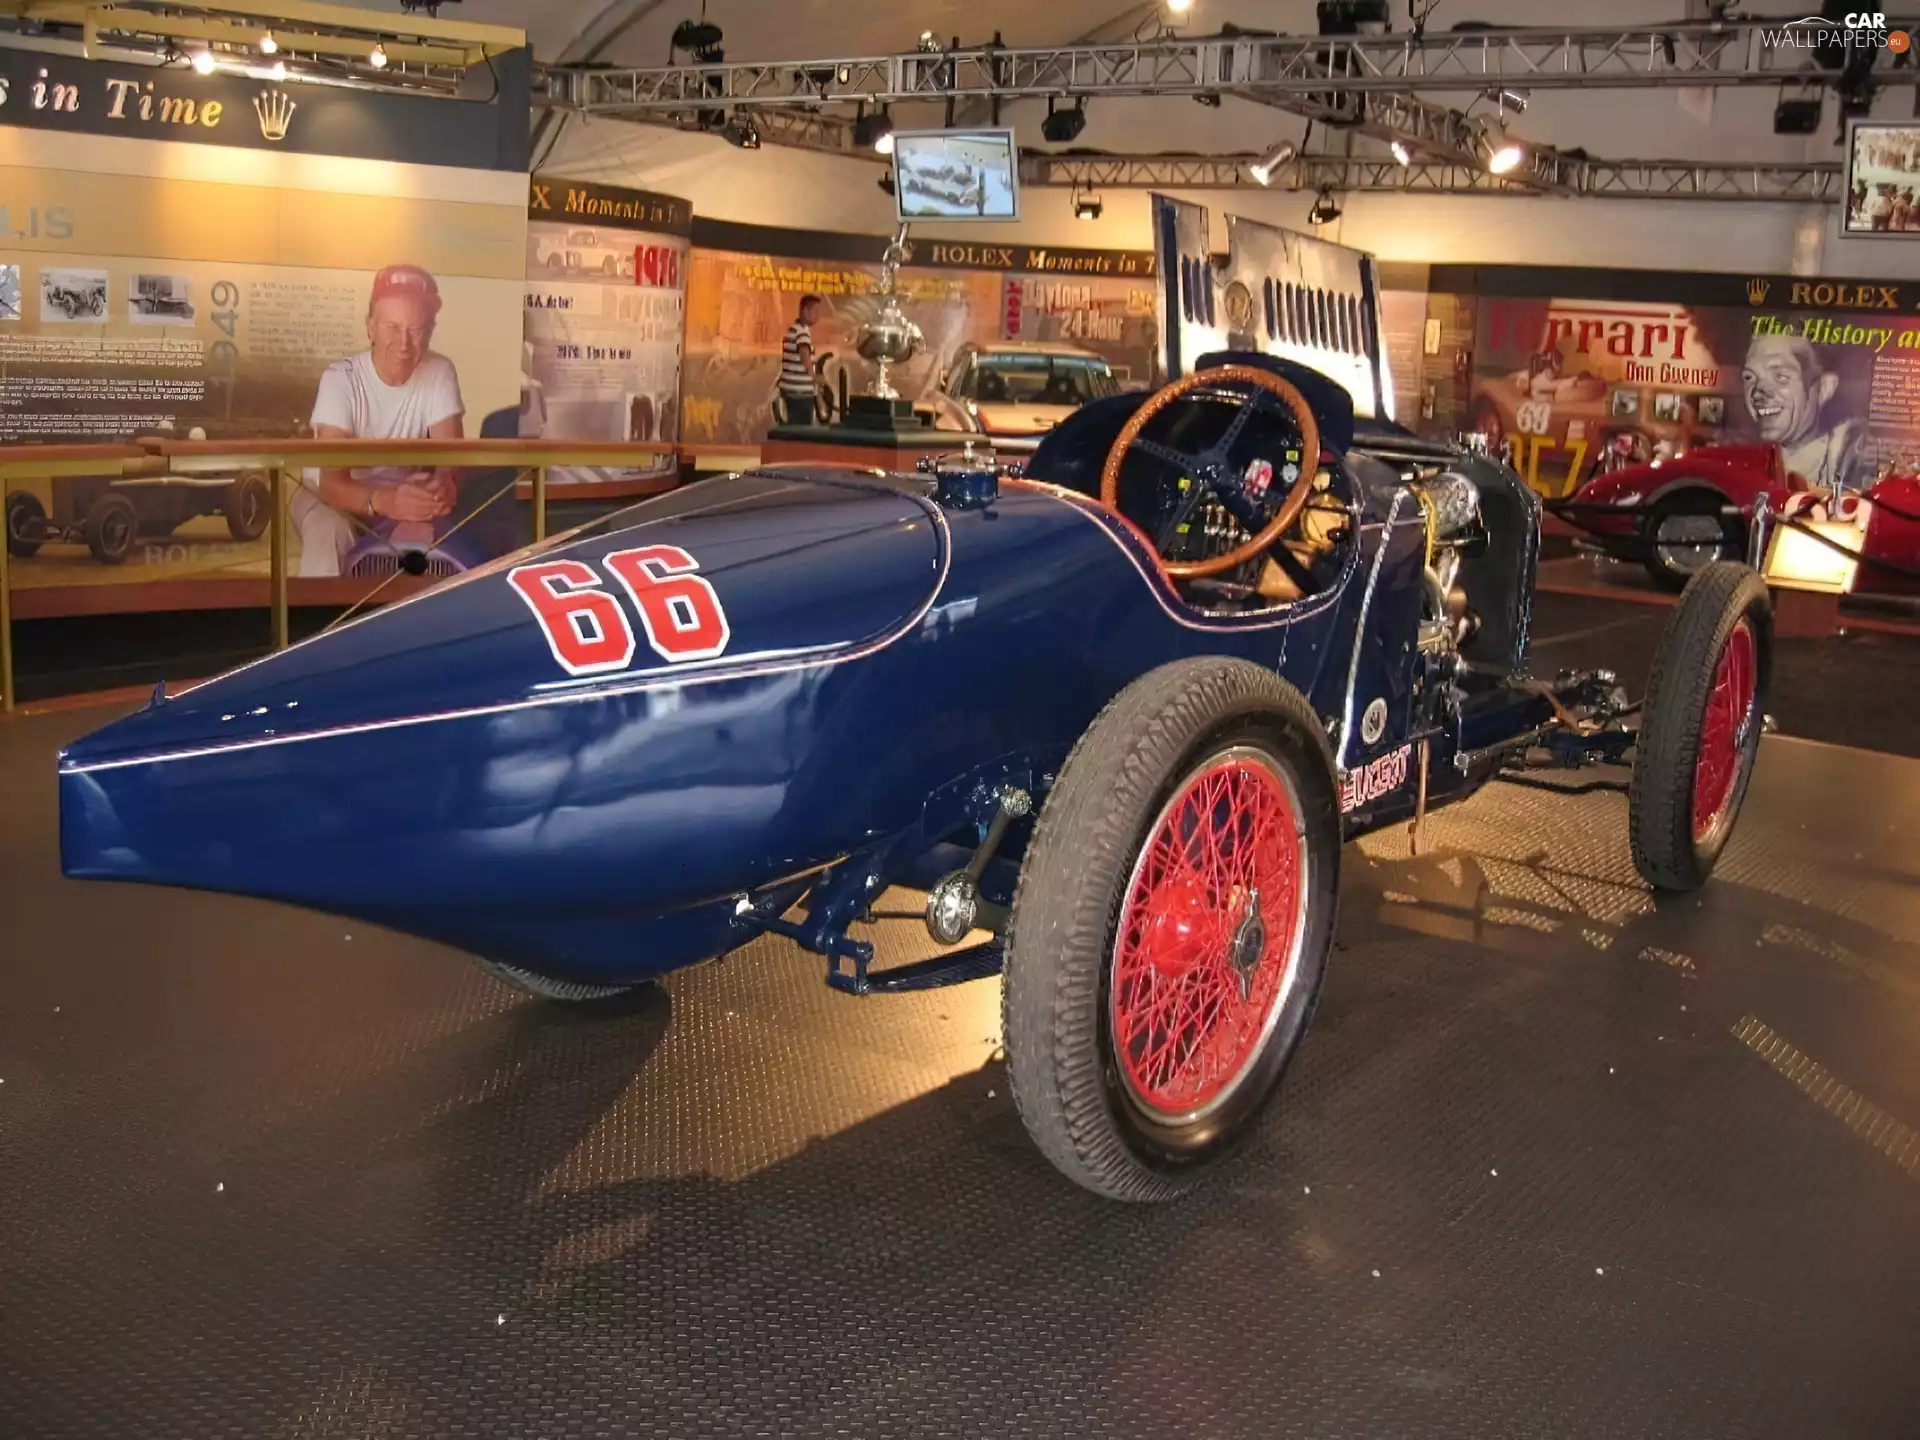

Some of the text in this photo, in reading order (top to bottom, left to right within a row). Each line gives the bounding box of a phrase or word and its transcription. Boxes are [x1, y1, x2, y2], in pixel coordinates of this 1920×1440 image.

[31, 67, 79, 112] in
[105, 78, 223, 128] Time
[564, 188, 645, 220] Moments
[932, 245, 1013, 266] ROLEX
[1025, 250, 1110, 272] Moments
[1118, 253, 1136, 273] in
[1790, 283, 1899, 308] ROLEX
[1490, 303, 1689, 360] Ferrari
[1803, 318, 1893, 353] History
[1897, 331, 1920, 349] a
[506, 544, 730, 676] 66
